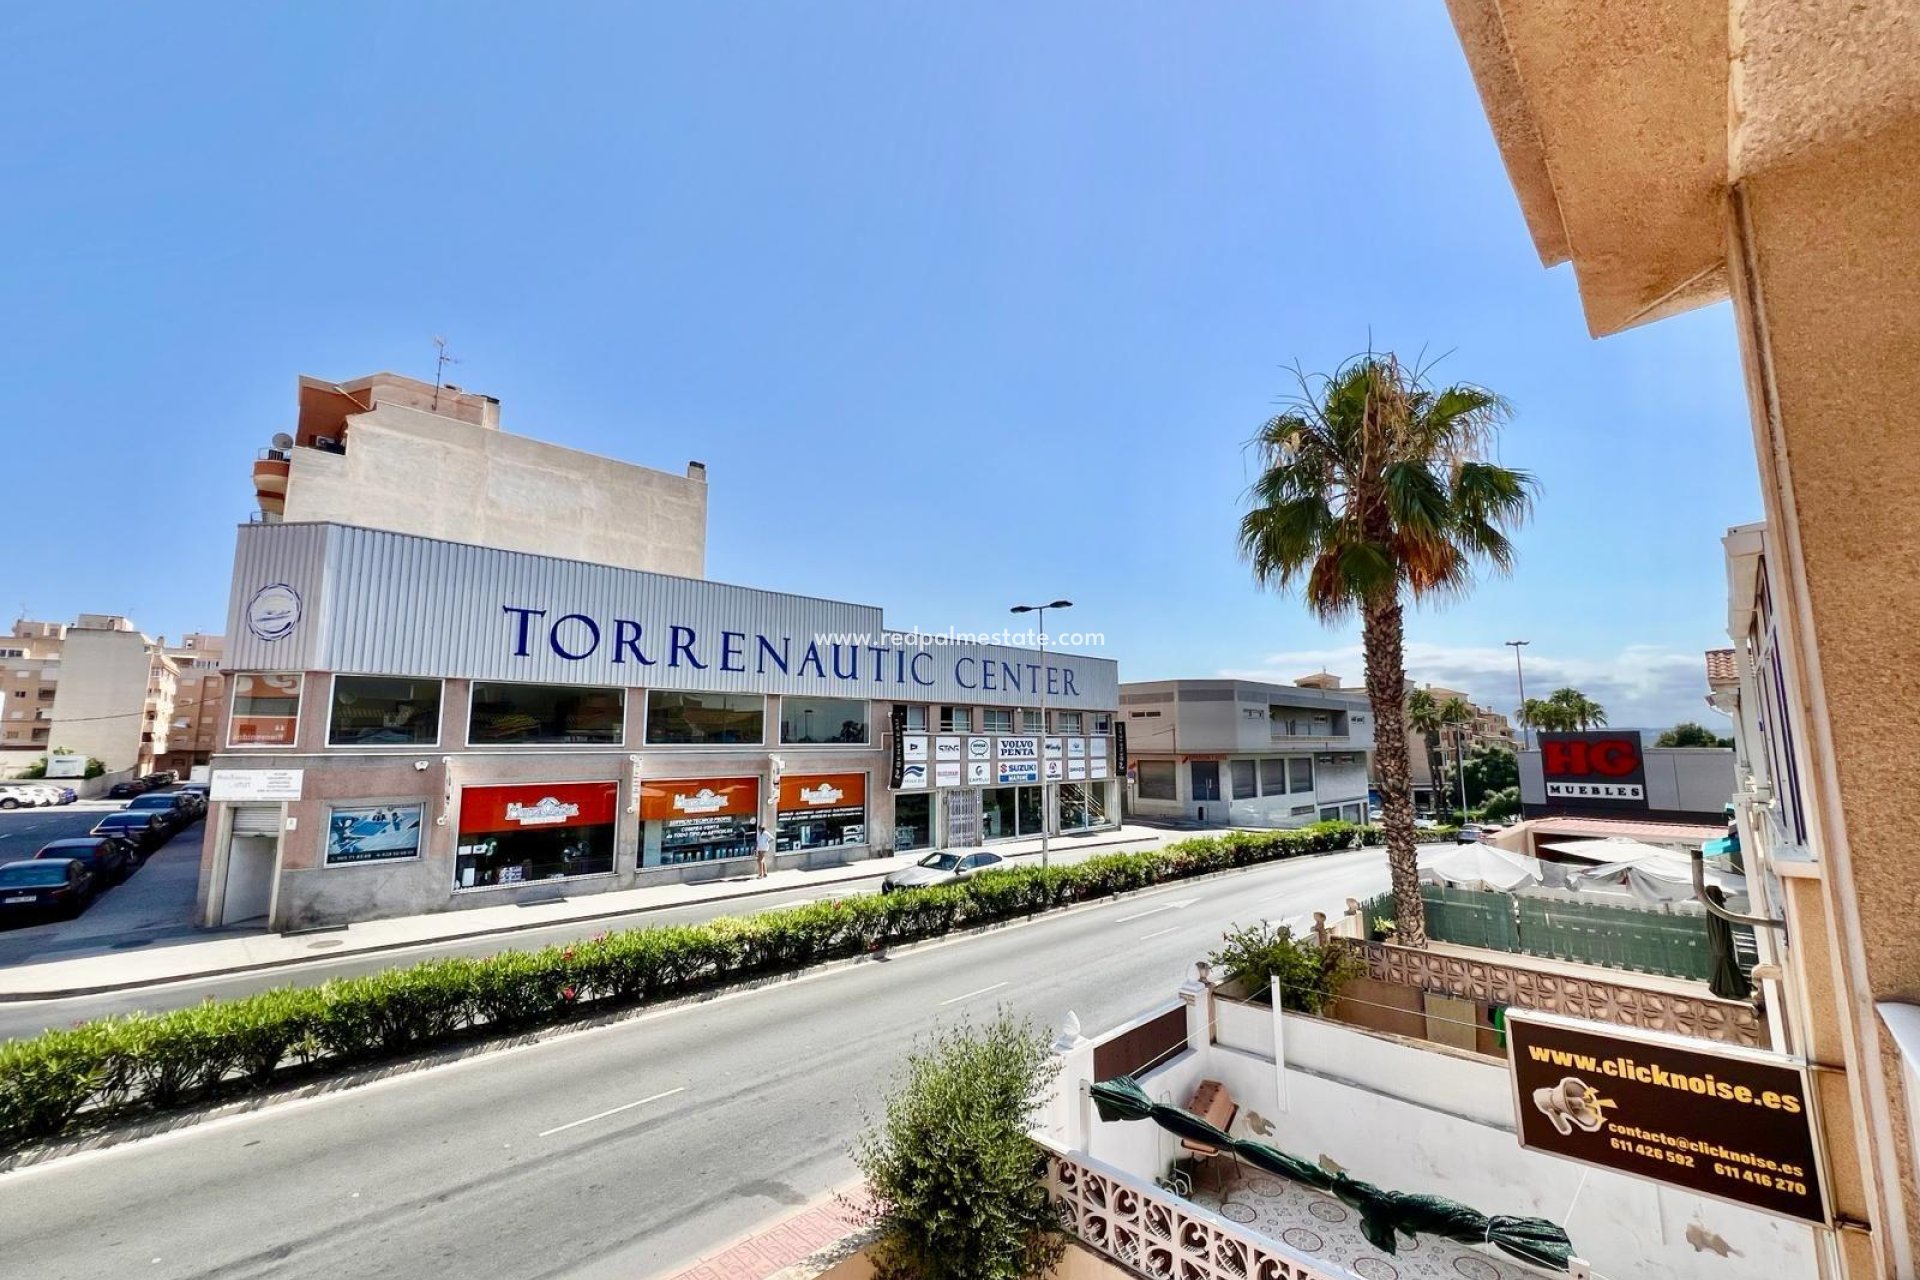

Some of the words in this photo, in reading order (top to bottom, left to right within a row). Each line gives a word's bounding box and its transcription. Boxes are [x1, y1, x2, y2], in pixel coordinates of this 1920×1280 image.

[503, 605, 935, 686] TORRENAUTIC
[955, 657, 1080, 696] CENTER
[1001, 740, 1034, 748] VOLVO
[1001, 748, 1035, 756] PENTA
[1542, 740, 1639, 777] HG
[1008, 764, 1036, 772] SUZUKI
[1550, 785, 1640, 797] MUEBLES
[1528, 1044, 1801, 1114] www.clicknoise.es
[1608, 1122, 1804, 1177] contacto@clicknoise.es
[1610, 1137, 1633, 1153] 611
[1635, 1143, 1664, 1160] 426
[1666, 1151, 1695, 1168] 592
[1714, 1162, 1740, 1179] 611
[1743, 1170, 1772, 1187] 416
[1775, 1178, 1806, 1195] 270
